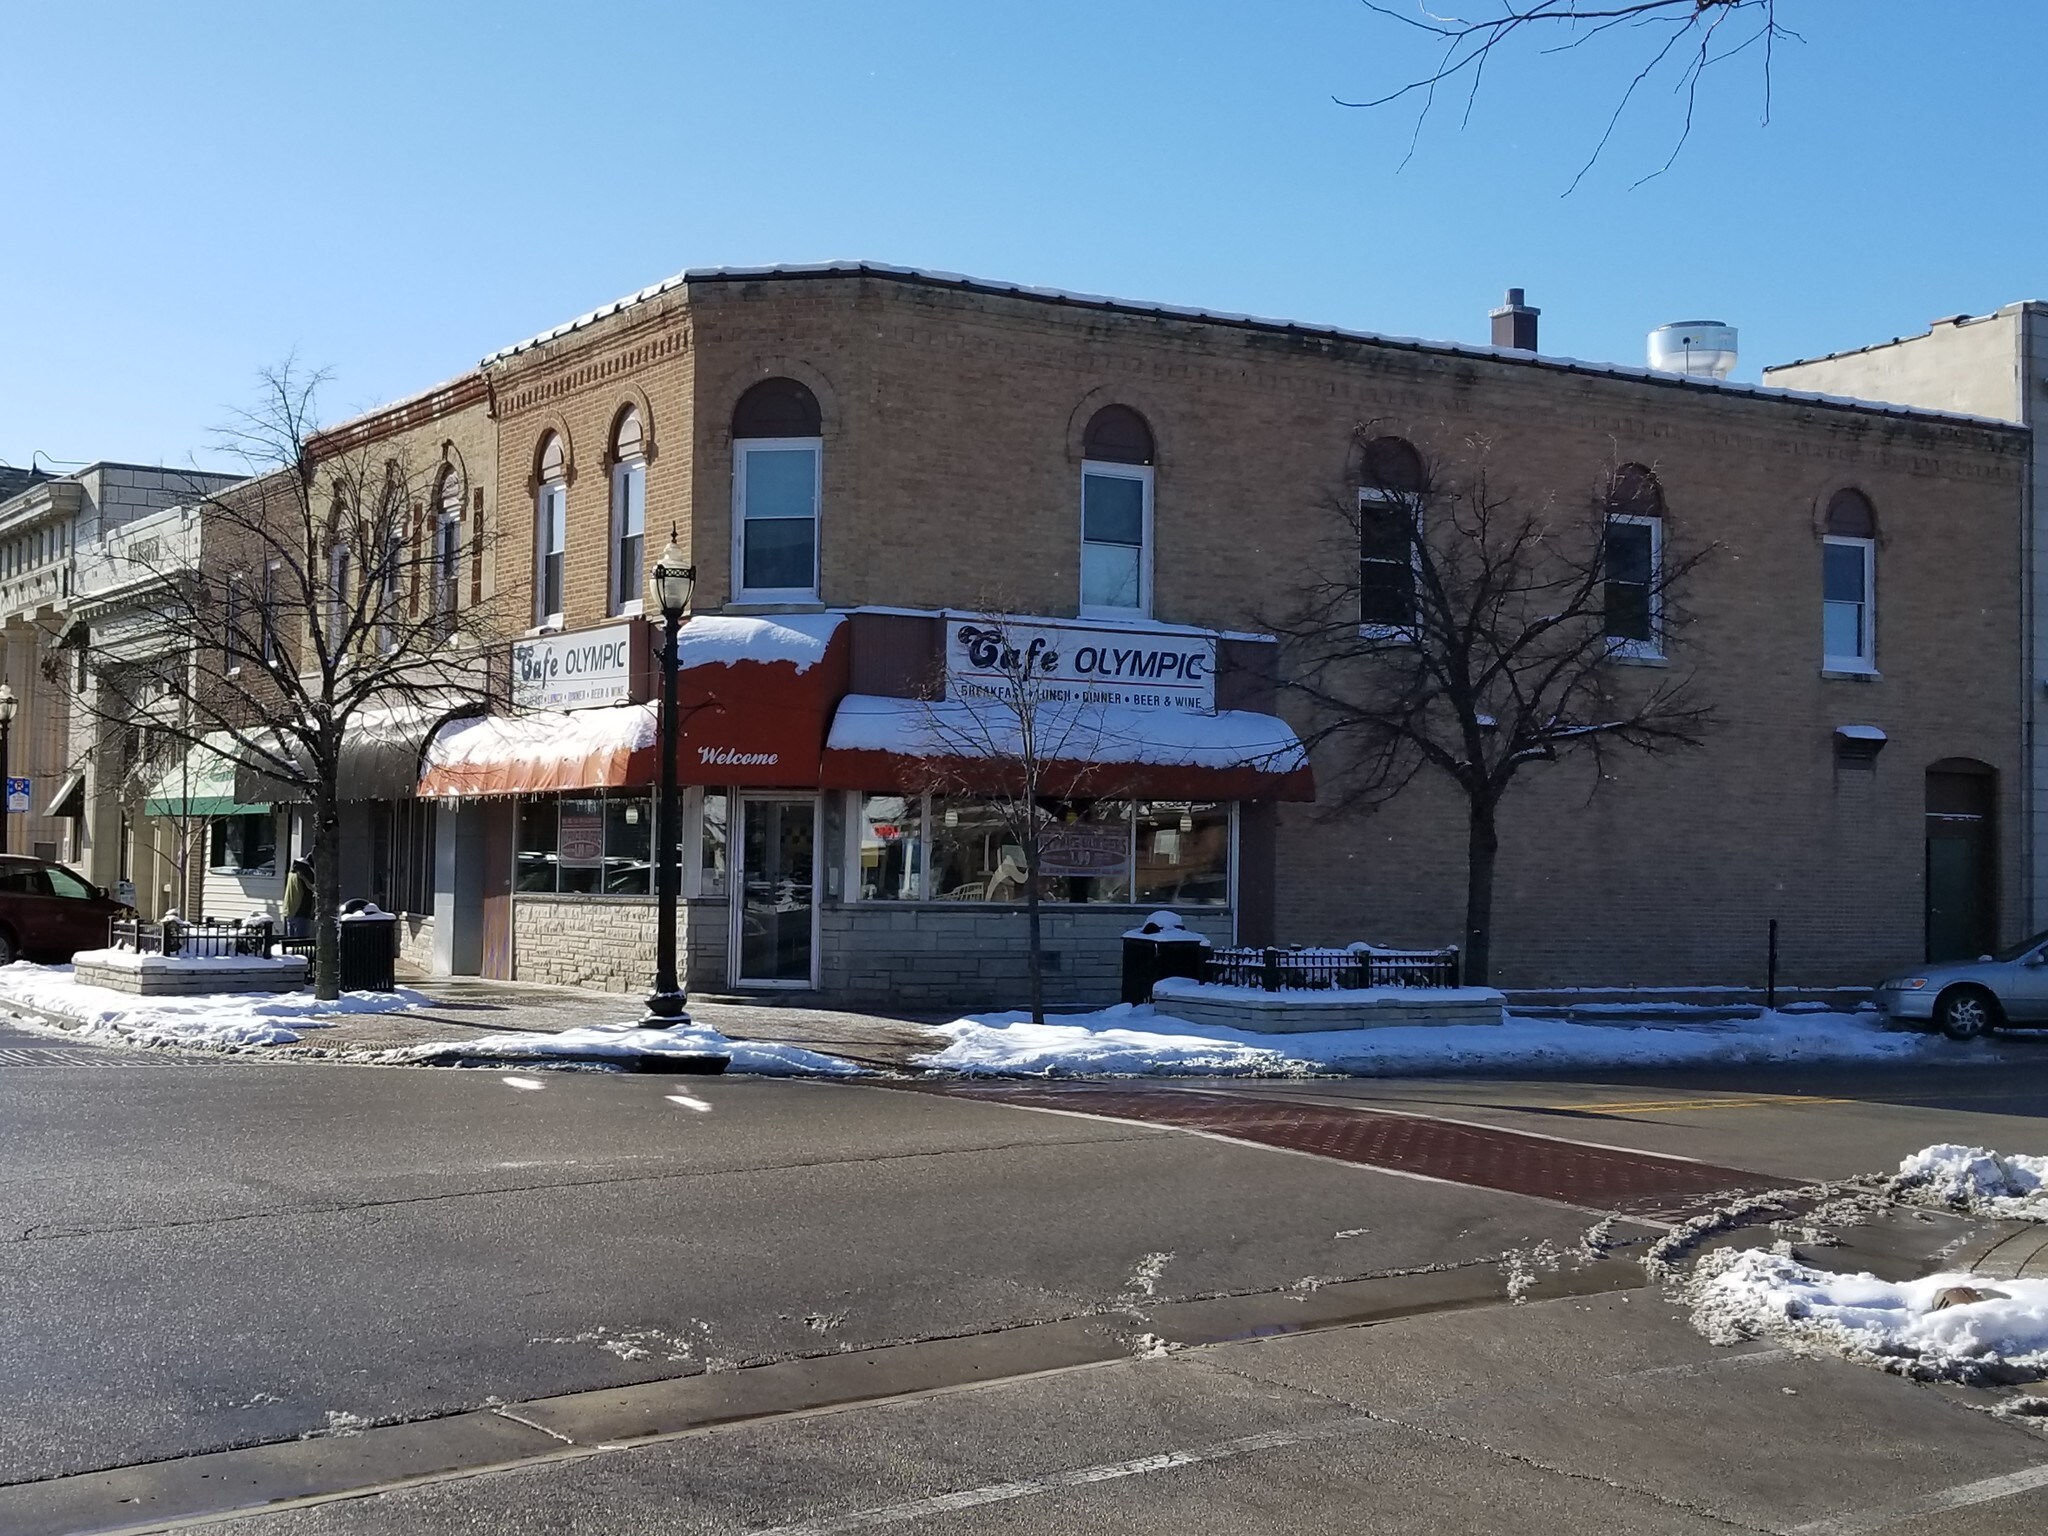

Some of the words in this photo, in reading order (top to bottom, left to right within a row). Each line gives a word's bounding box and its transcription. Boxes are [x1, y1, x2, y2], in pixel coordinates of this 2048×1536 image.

[517, 645, 559, 689] Cafe
[565, 641, 626, 674] OLYMPIC
[957, 625, 1059, 682] Cafe
[1075, 647, 1205, 680] OLYMPIC
[961, 685, 1025, 699] BREAKFAST
[1082, 691, 1121, 704] DINNER
[1133, 694, 1160, 706] BEER
[1163, 696, 1172, 707] &
[1174, 696, 1201, 708] WINE
[697, 746, 779, 765] Welcome
